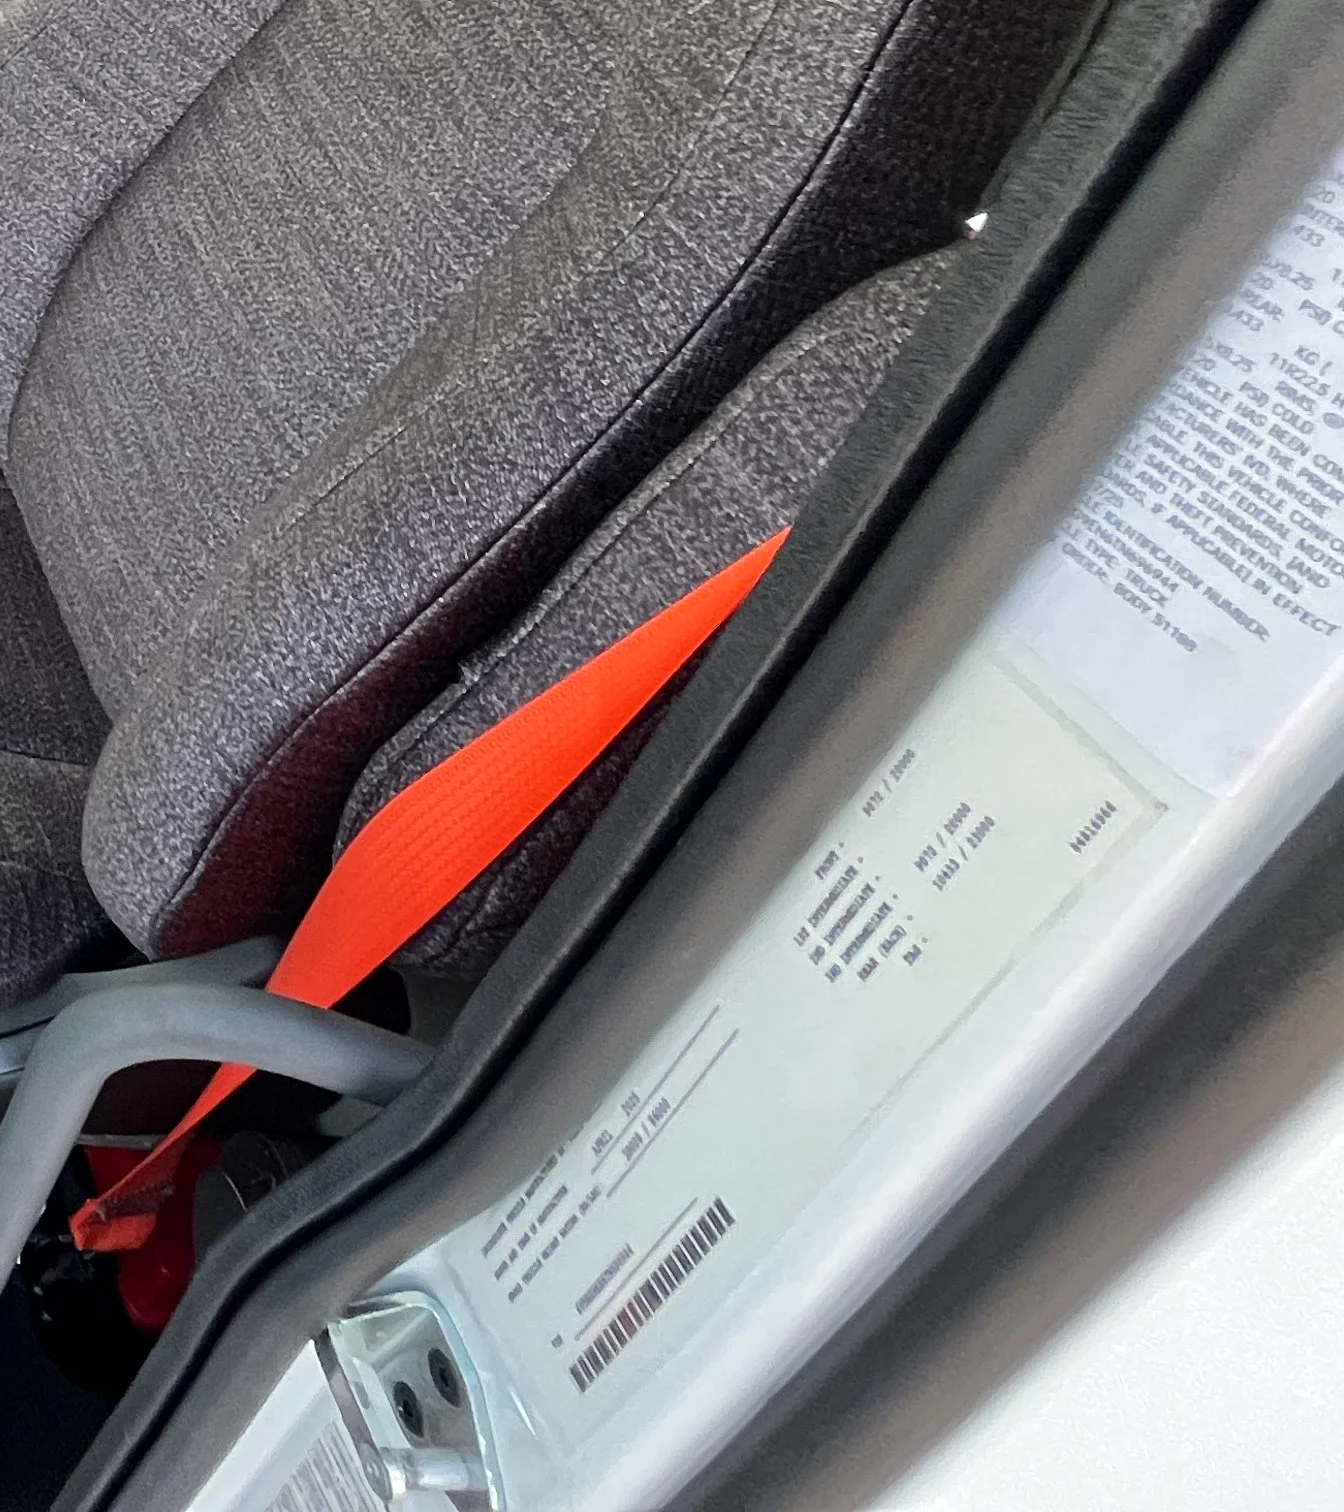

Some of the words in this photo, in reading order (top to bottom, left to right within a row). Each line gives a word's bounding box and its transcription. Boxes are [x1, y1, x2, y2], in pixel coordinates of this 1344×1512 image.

[1234, 401, 1267, 428] HAS
[1268, 423, 1310, 457] BEEN
[1270, 401, 1315, 436] COLD
[1143, 452, 1196, 493] SAFETY
[1146, 432, 1231, 495] APPLICABLE
[1227, 490, 1291, 539] FEDERAL
[1191, 441, 1226, 469] THIS
[1226, 464, 1288, 511] VEHICLE
[1224, 418, 1264, 449] WITH
[1266, 445, 1296, 470] THE
[1296, 466, 1344, 504] PRIOR
[1274, 474, 1331, 517] WHERE
[1102, 509, 1203, 589] IDENTIFICATION
[1135, 468, 1168, 495] AND
[1168, 492, 1213, 527] THEFT
[1211, 524, 1303, 595] PREVENTION
[1112, 581, 1152, 616] BODY
[1122, 568, 1169, 607] TRUCK
[1252, 577, 1271, 595] IN
[1272, 592, 1339, 637] EFFECT
